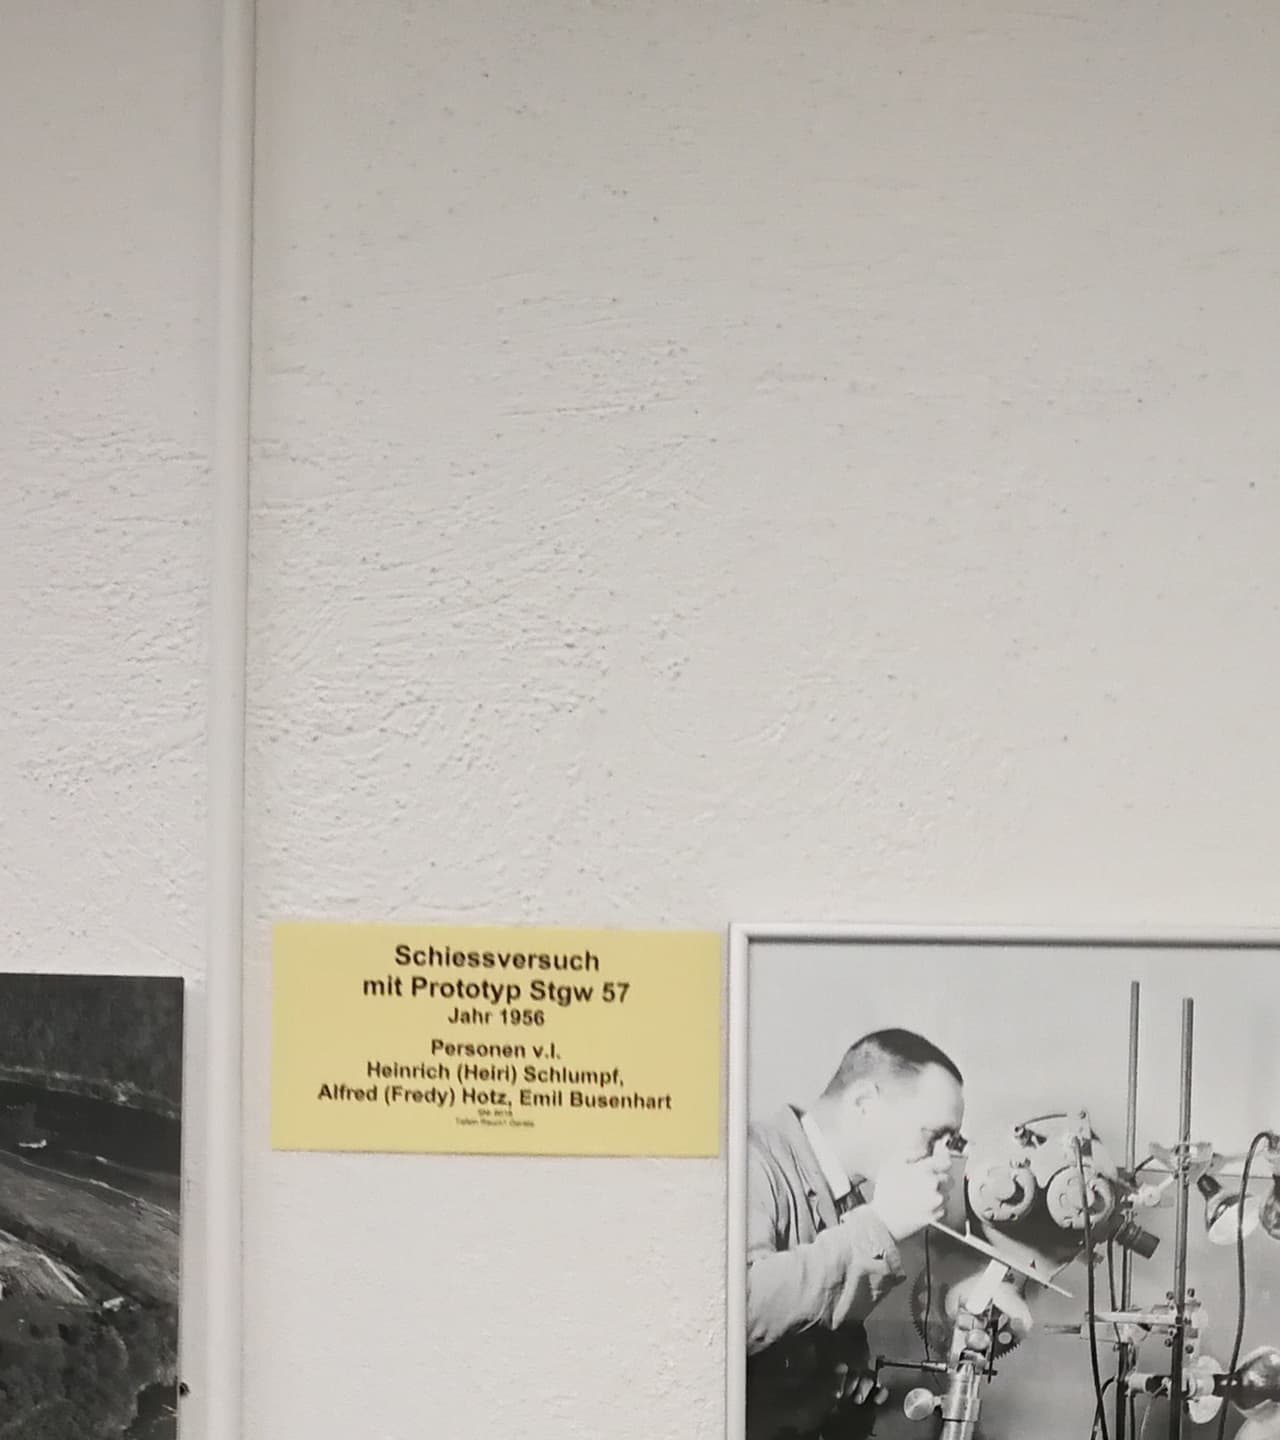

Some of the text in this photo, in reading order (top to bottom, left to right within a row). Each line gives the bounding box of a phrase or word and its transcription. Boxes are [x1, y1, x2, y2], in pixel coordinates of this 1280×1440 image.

[394, 944, 600, 973] Schiessversuch
[362, 973, 631, 1008] mit Prototyp Stgw 57
[447, 1006, 546, 1027] Jahr 1956
[430, 1038, 561, 1060] Personen v.l.
[366, 1060, 624, 1089] Heinrich (Heiri) Schlumpf,
[316, 1083, 673, 1110] Alfred (Fredy) Hotz, Emil Busenhart
